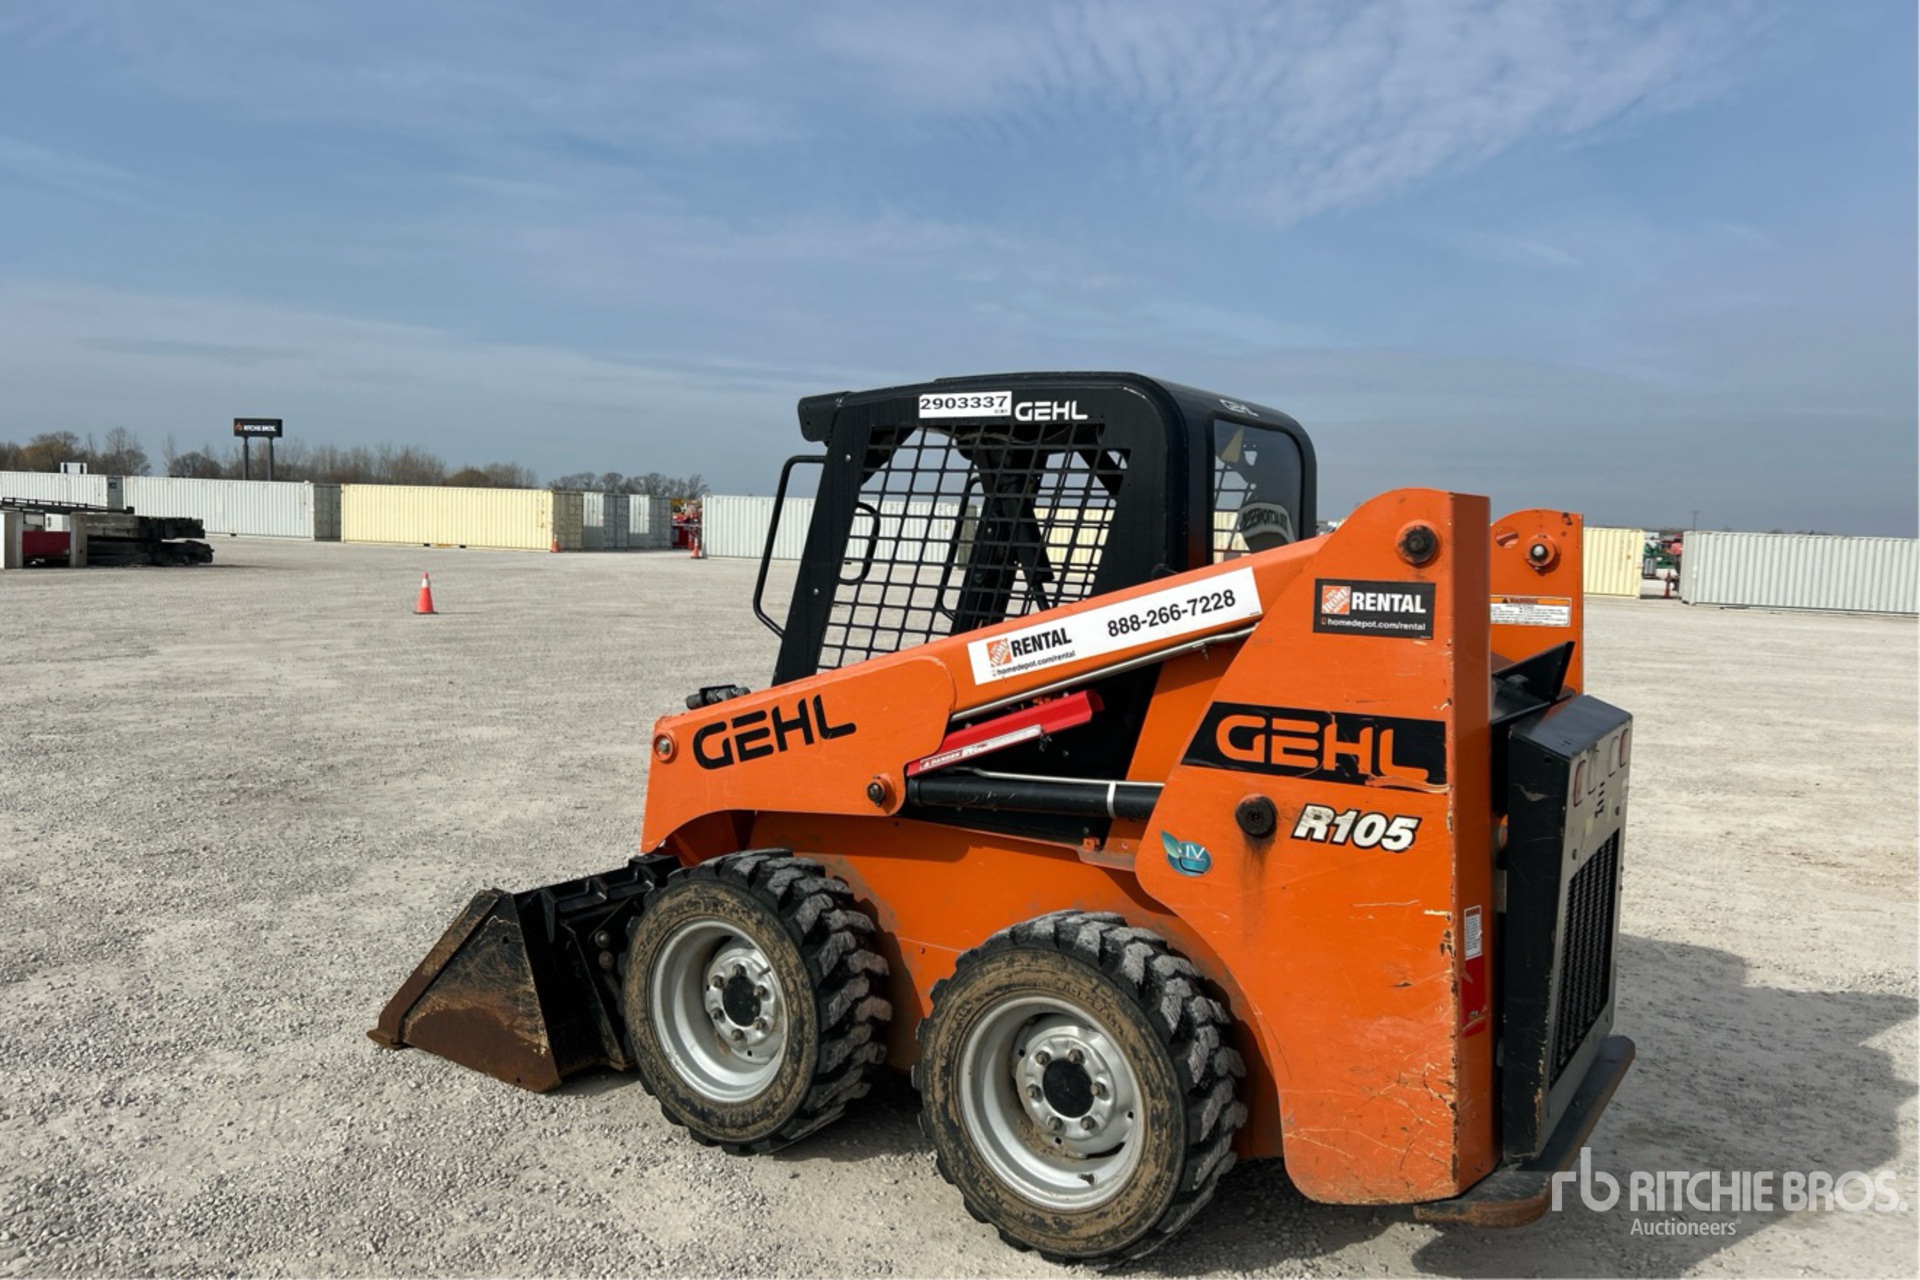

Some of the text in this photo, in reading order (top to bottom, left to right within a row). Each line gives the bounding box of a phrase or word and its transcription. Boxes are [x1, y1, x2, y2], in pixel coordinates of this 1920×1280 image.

[920, 396, 1008, 410] 2903337
[1014, 401, 1088, 421] GEHL
[1107, 589, 1236, 637] 888-266-7228
[1351, 592, 1426, 613] RENTAL
[1328, 618, 1426, 631] homedepot.com/rental
[1011, 627, 1072, 657] RENTAL
[997, 650, 1076, 675] homedepot.com/rental
[692, 694, 857, 770] GEHL
[1216, 714, 1429, 784] GEHL
[1291, 803, 1422, 853] R105
